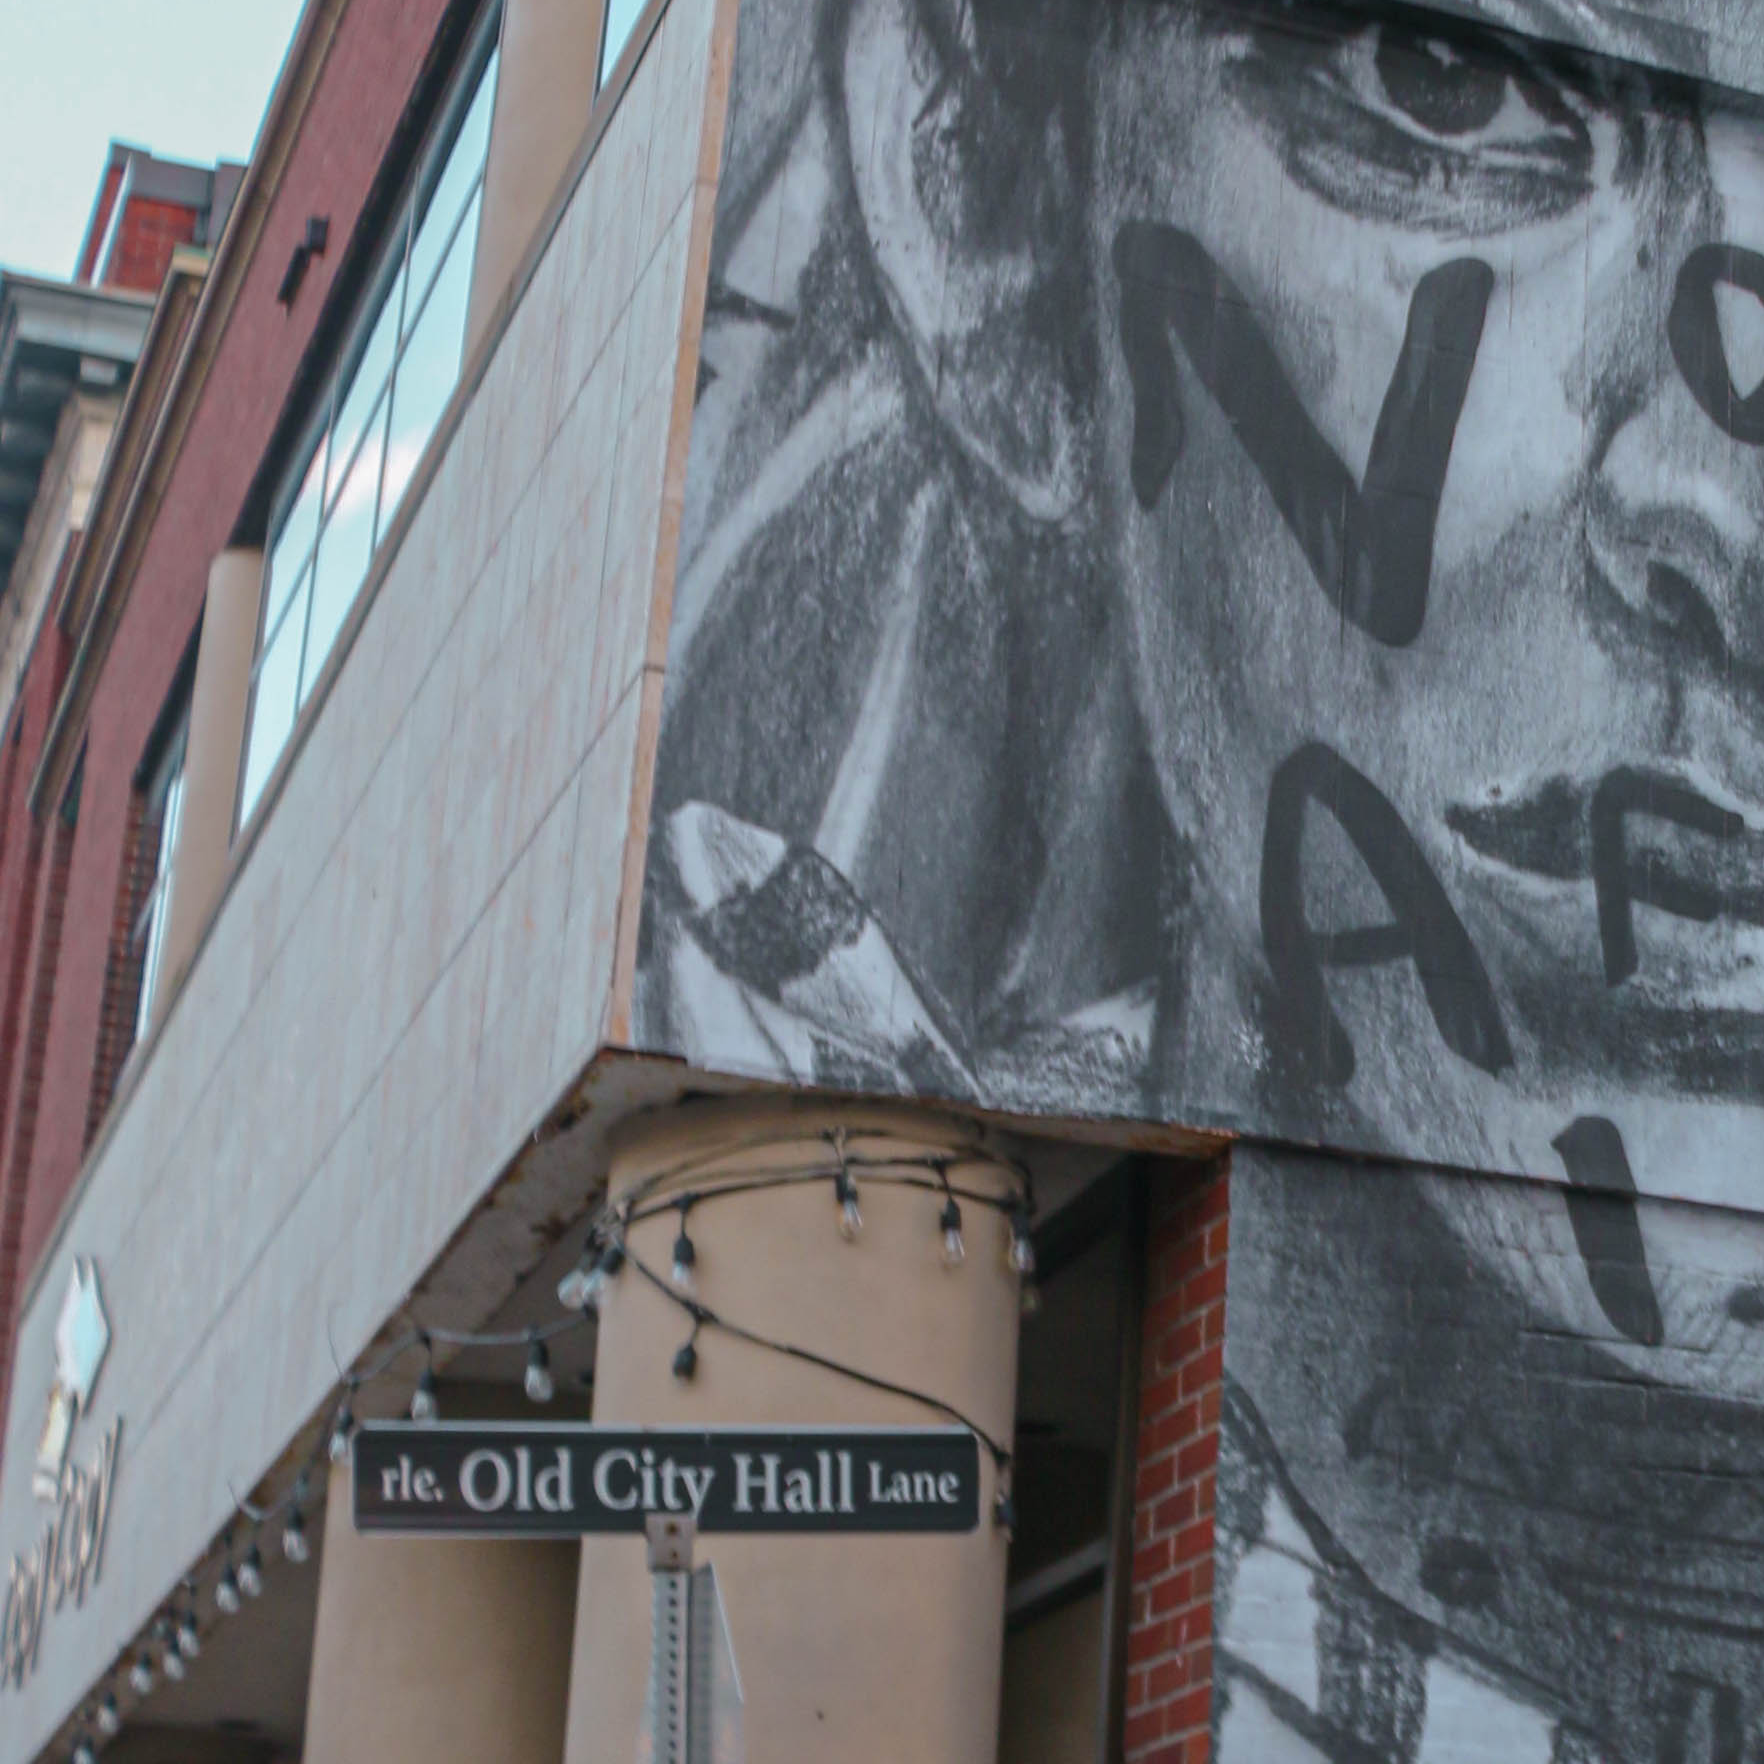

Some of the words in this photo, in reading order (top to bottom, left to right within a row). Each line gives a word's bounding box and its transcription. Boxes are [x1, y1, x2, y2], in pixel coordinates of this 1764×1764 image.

[459, 1447, 574, 1514] Old
[593, 1447, 715, 1518] City
[732, 1451, 856, 1514] Hall
[868, 1461, 960, 1505] Lane
